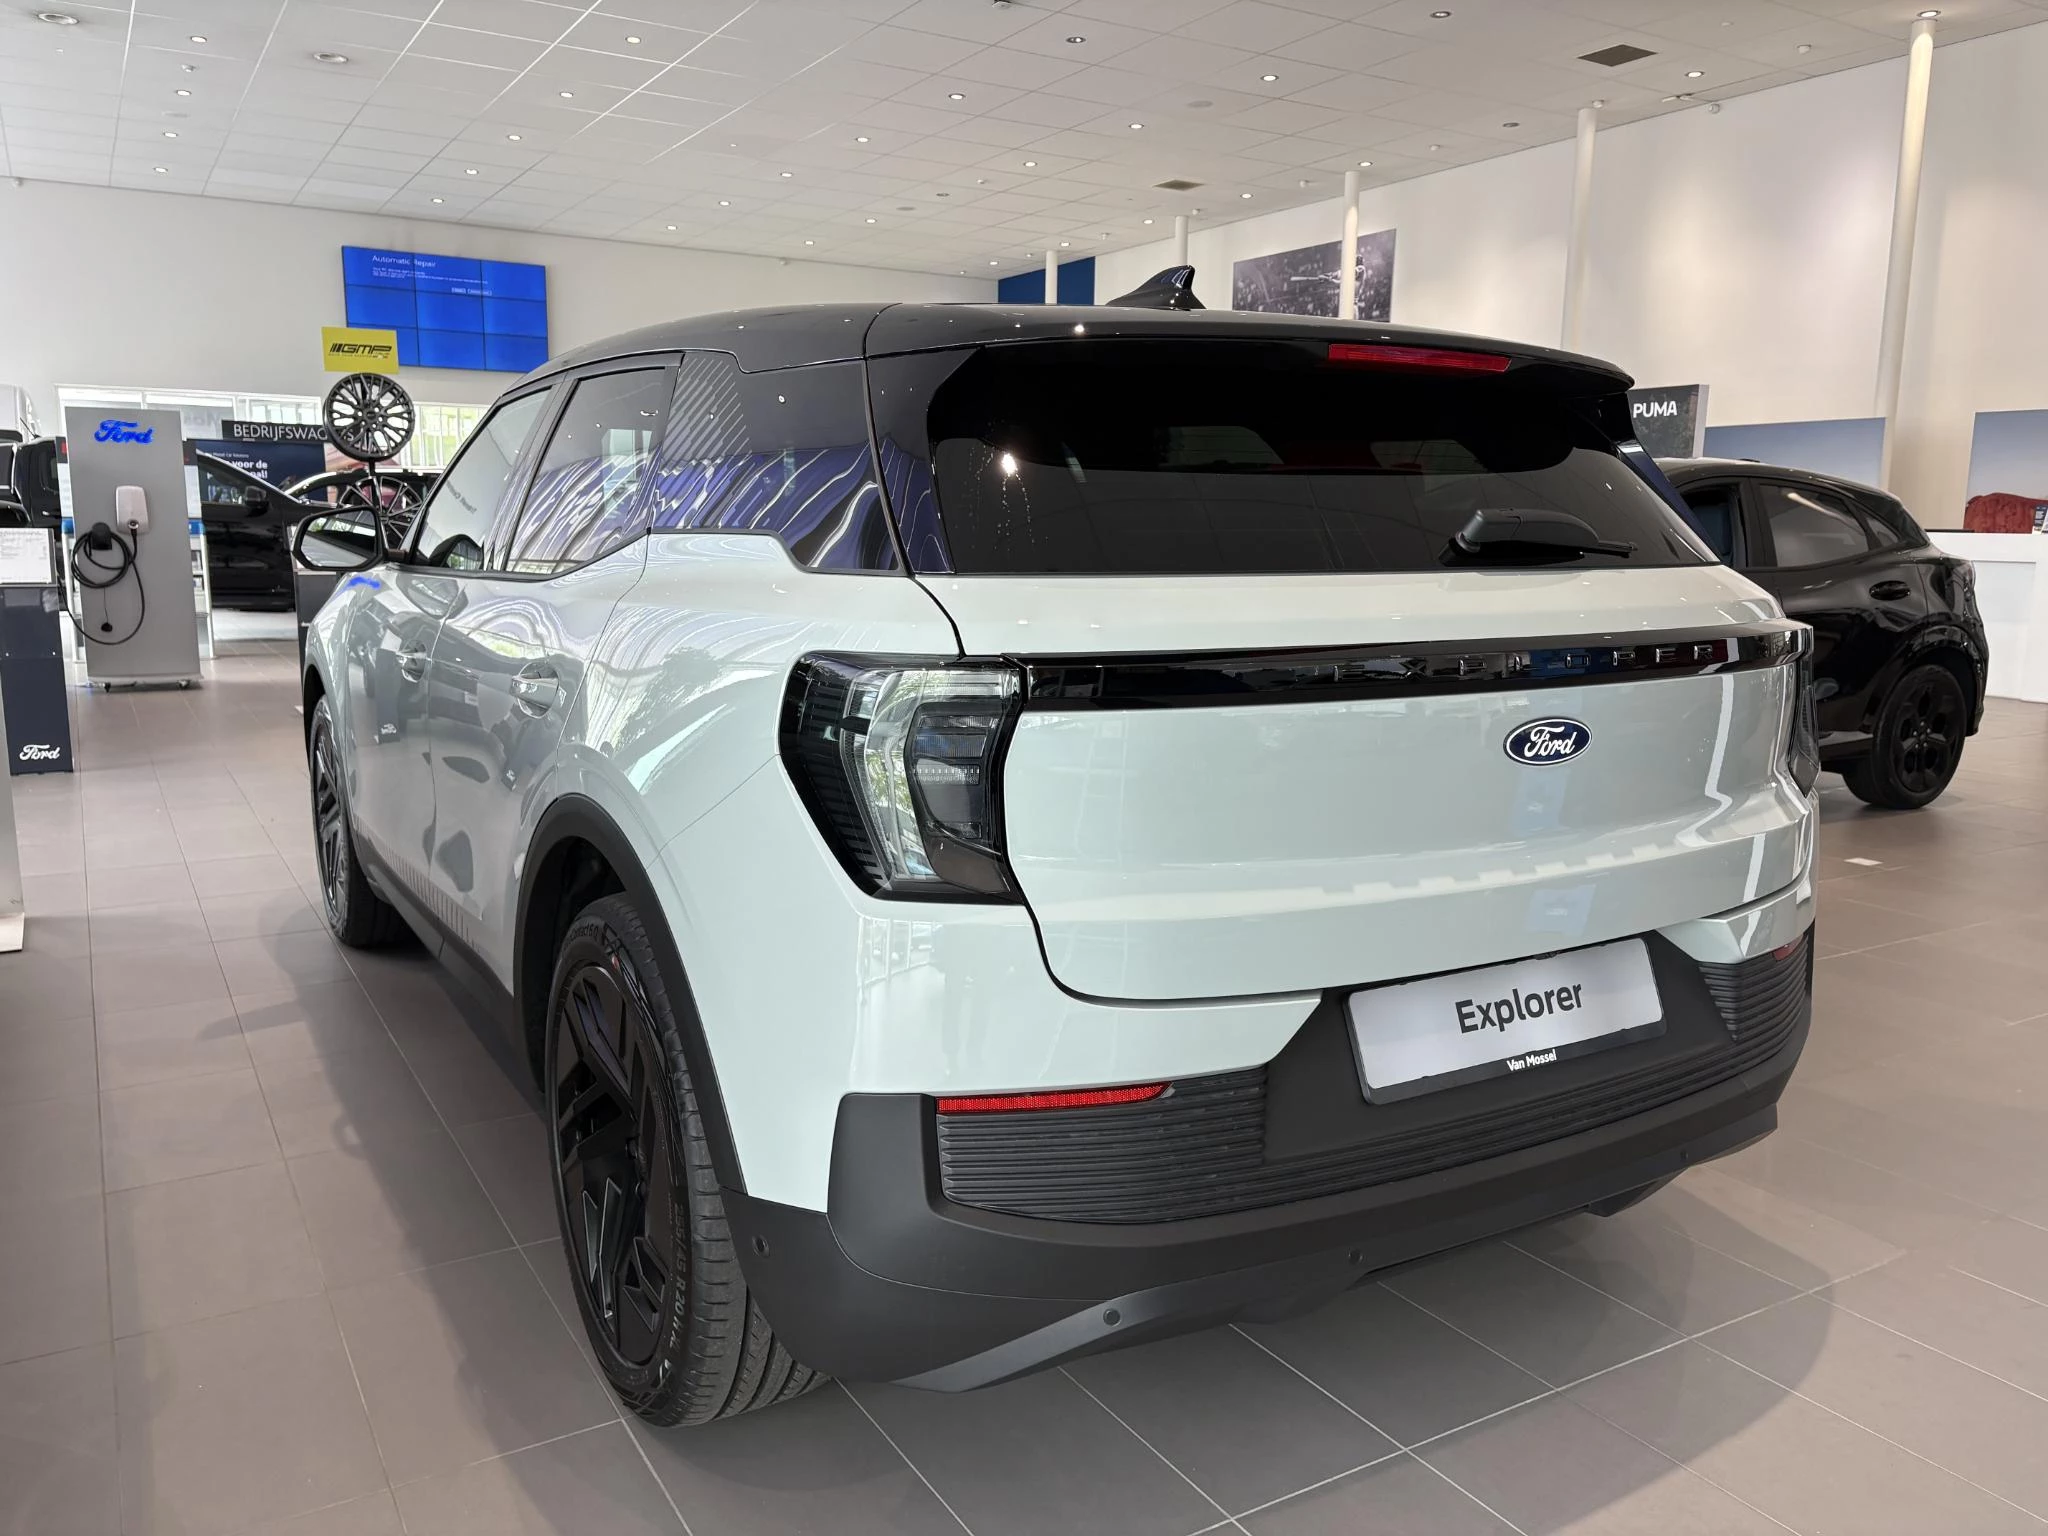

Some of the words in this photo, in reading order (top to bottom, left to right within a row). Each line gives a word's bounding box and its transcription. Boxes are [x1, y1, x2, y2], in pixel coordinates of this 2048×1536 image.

[372, 255, 411, 265] Automatic
[341, 343, 393, 355] GMP
[1633, 400, 1678, 418] PUMA
[94, 419, 153, 444] Ford
[255, 459, 268, 469] de
[1333, 643, 1717, 683] EXPLORER
[19, 744, 61, 760] Ford
[1524, 726, 1577, 757] Ford
[1455, 983, 1582, 1034] Explorer
[1507, 1055, 1526, 1072] Van
[1526, 1048, 1557, 1067] Mossel
